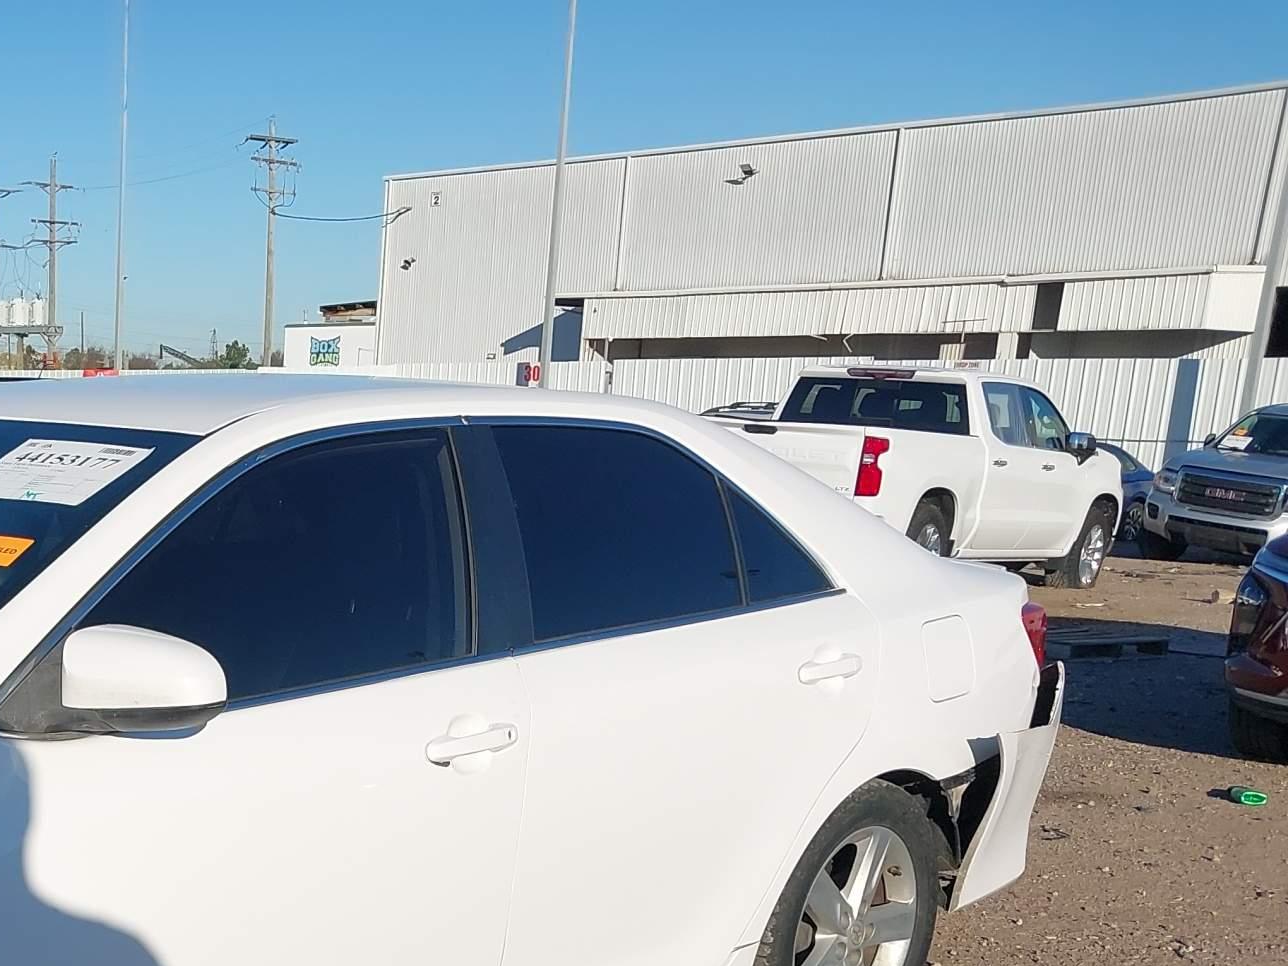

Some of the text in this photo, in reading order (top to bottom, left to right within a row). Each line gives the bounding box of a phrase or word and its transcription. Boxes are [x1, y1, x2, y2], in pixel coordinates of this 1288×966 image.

[311, 337, 340, 353] BOX
[524, 365, 540, 382] 30
[16, 451, 121, 470] 44153177
[1205, 487, 1246, 501] GMC
